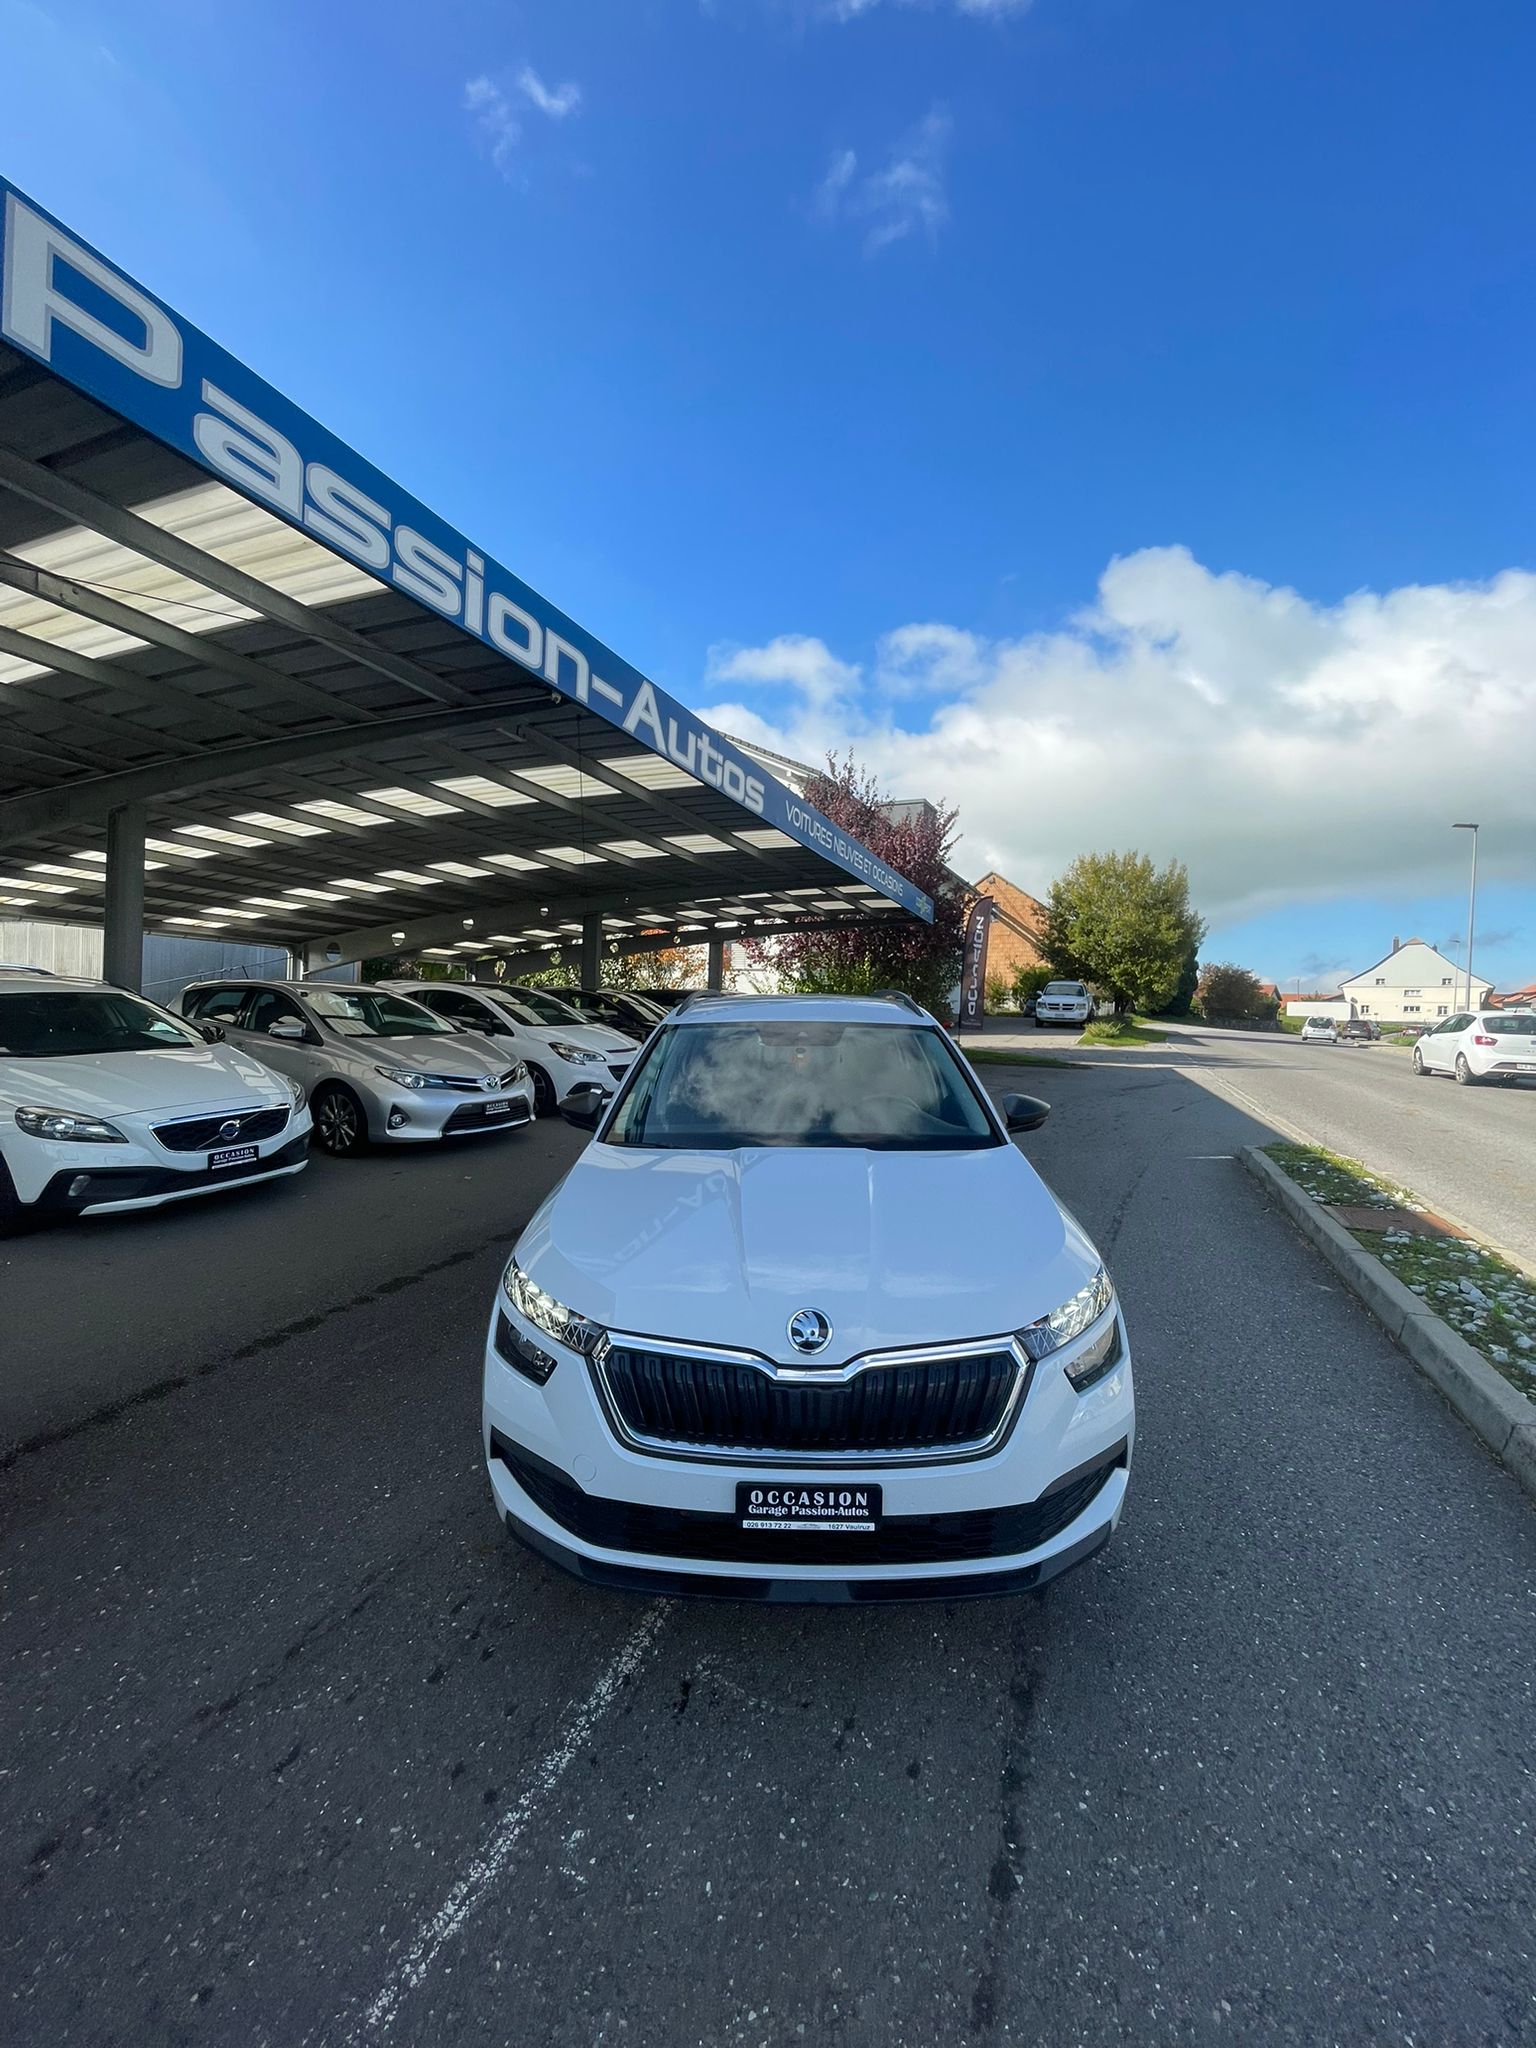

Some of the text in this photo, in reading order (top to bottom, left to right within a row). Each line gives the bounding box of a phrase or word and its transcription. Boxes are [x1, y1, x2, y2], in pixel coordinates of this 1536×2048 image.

[2, 189, 766, 815] Passion-Autos
[785, 799, 833, 850] VOITURES
[833, 835, 864, 871] NEUVES
[863, 857, 872, 876] ET
[213, 1147, 255, 1160] OCCASION
[750, 1490, 868, 1506] OCCASION
[747, 1504, 870, 1517] Garage Passion-Autos
